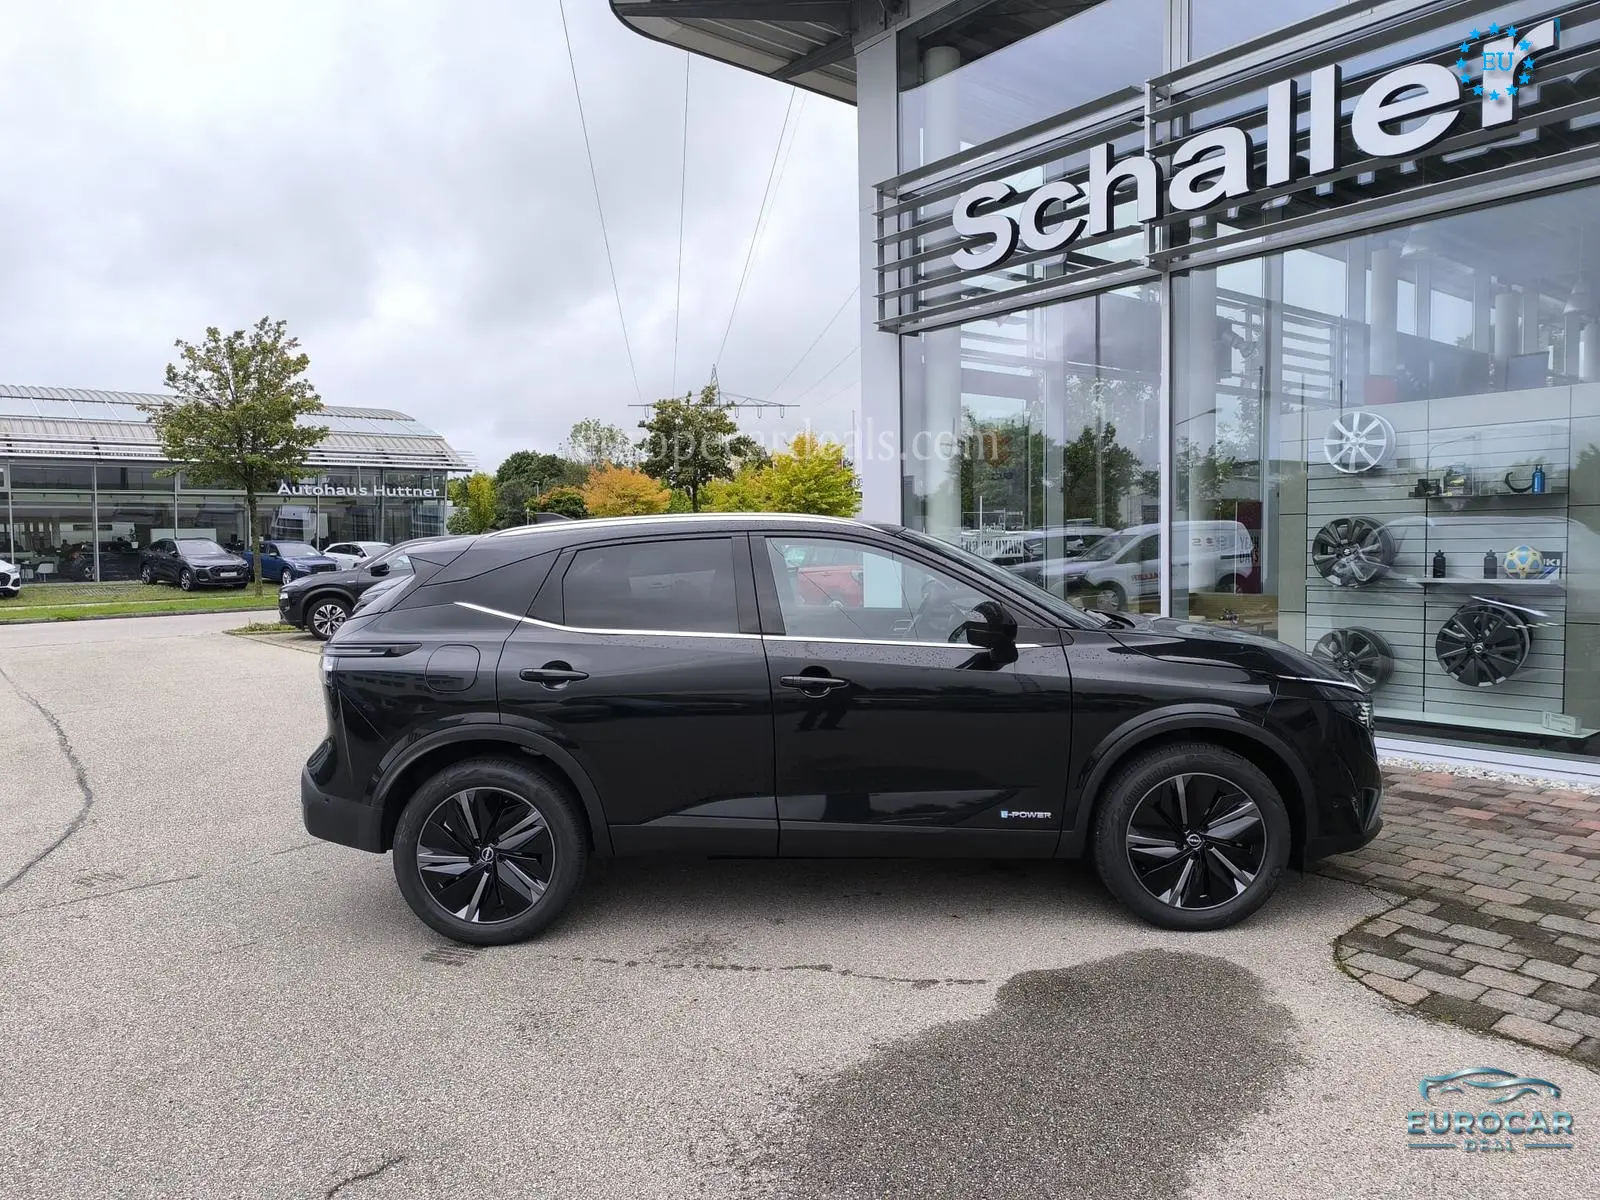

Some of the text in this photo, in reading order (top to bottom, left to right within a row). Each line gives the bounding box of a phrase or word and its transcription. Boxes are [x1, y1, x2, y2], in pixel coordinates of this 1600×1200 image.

[950, 20, 1558, 271] Schaller
[277, 483, 440, 497] Autohaus Huttner
